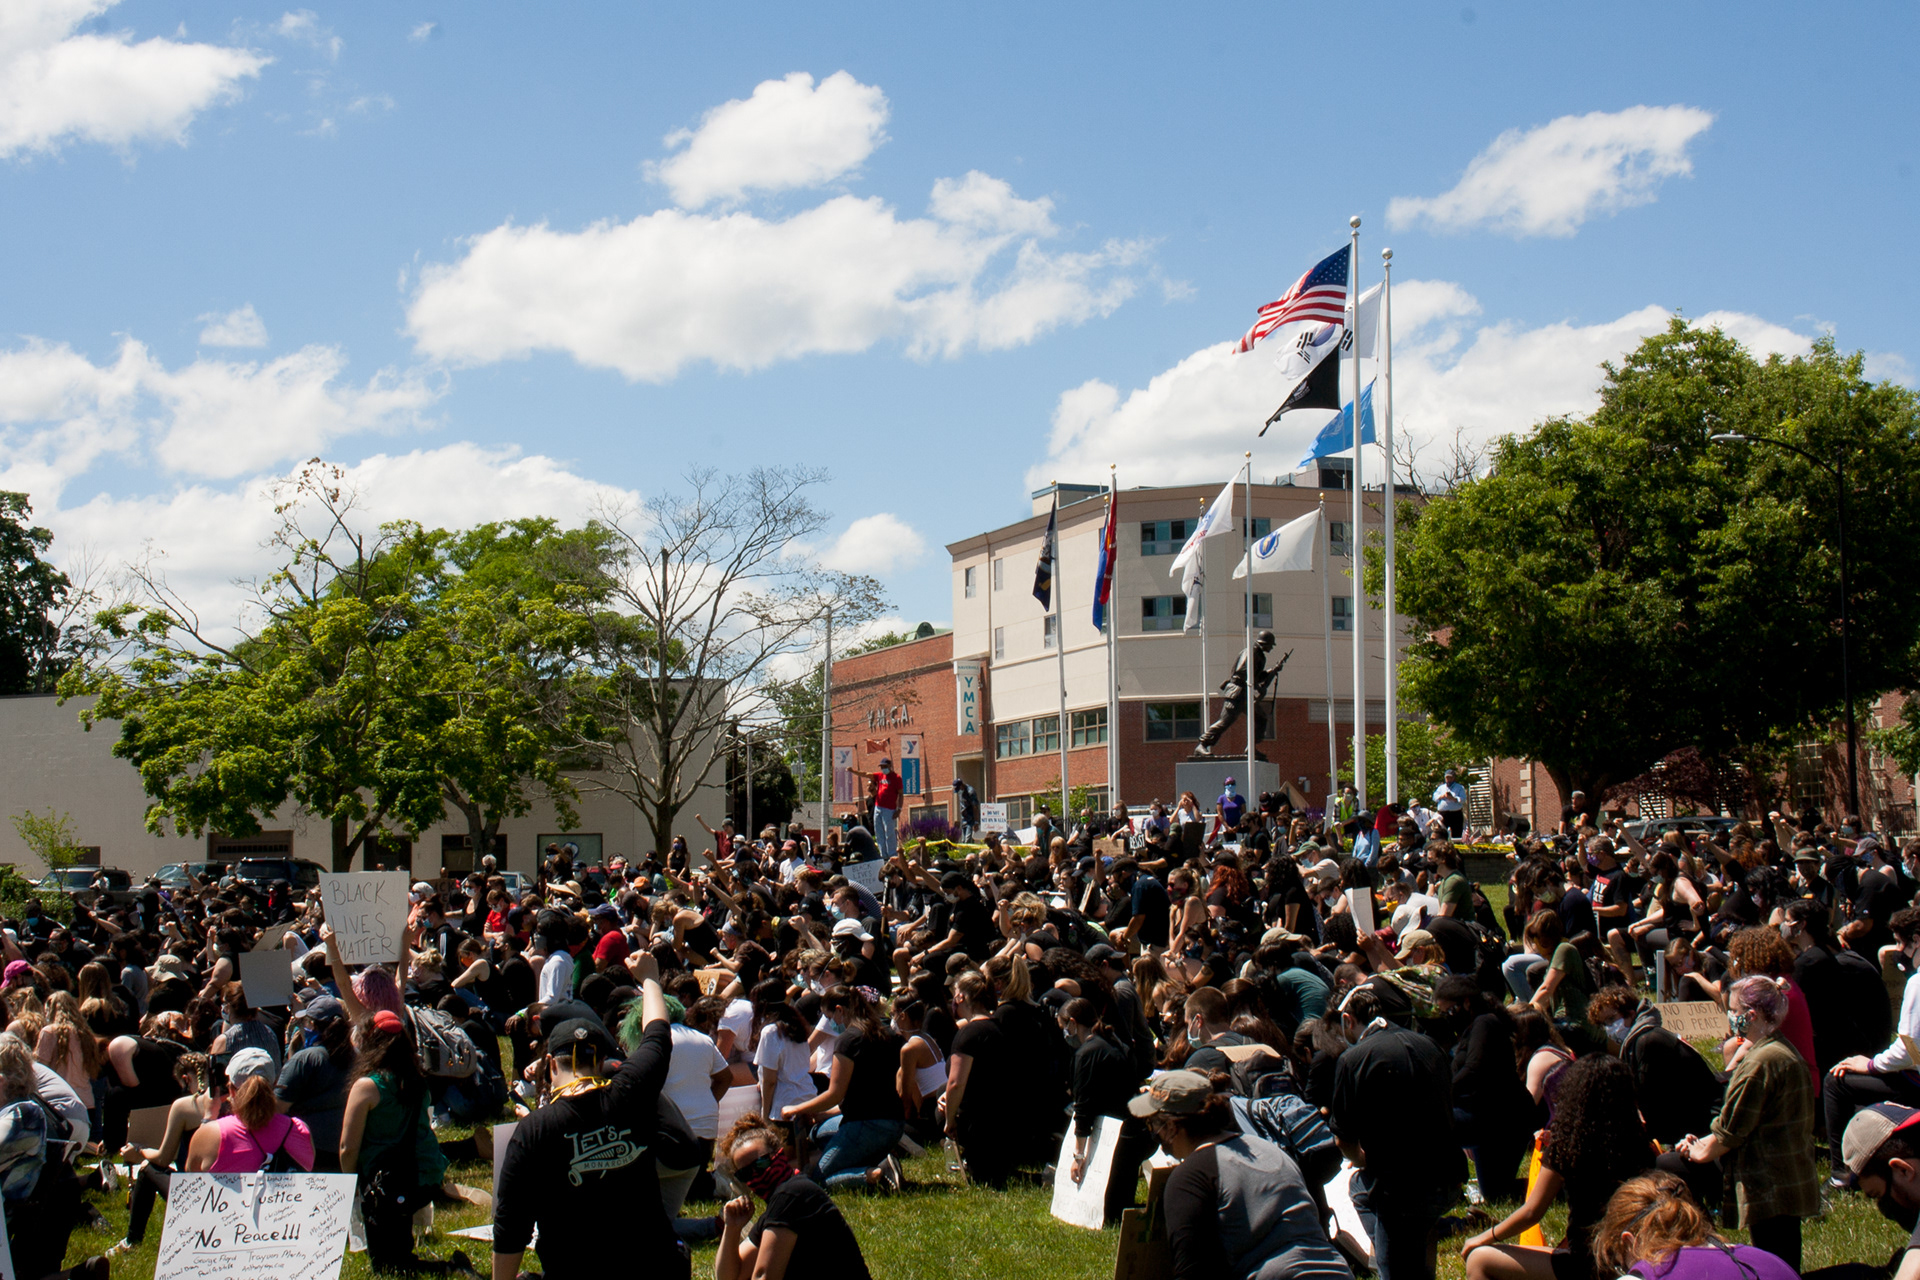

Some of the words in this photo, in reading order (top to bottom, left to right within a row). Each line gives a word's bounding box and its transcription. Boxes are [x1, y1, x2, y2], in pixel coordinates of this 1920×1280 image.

[963, 676, 975, 733] YMCA
[1129, 833, 1146, 849] RESIST
[852, 862, 872, 873] BLACK
[852, 869, 873, 880] LIVES
[856, 877, 876, 886] ATTER
[328, 879, 391, 906] BLACK
[330, 911, 386, 938] LIVES
[337, 936, 396, 961] MATTER
[1662, 1003, 1680, 1016] NO
[1687, 1002, 1723, 1016] JUSTIC
[1667, 1019, 1685, 1032] NO
[1690, 1016, 1721, 1031] PEACE
[583, 1154, 635, 1169] MONARCHS
[200, 1184, 229, 1214] No
[194, 1225, 222, 1250] No
[234, 1222, 301, 1245] Peace!!!
